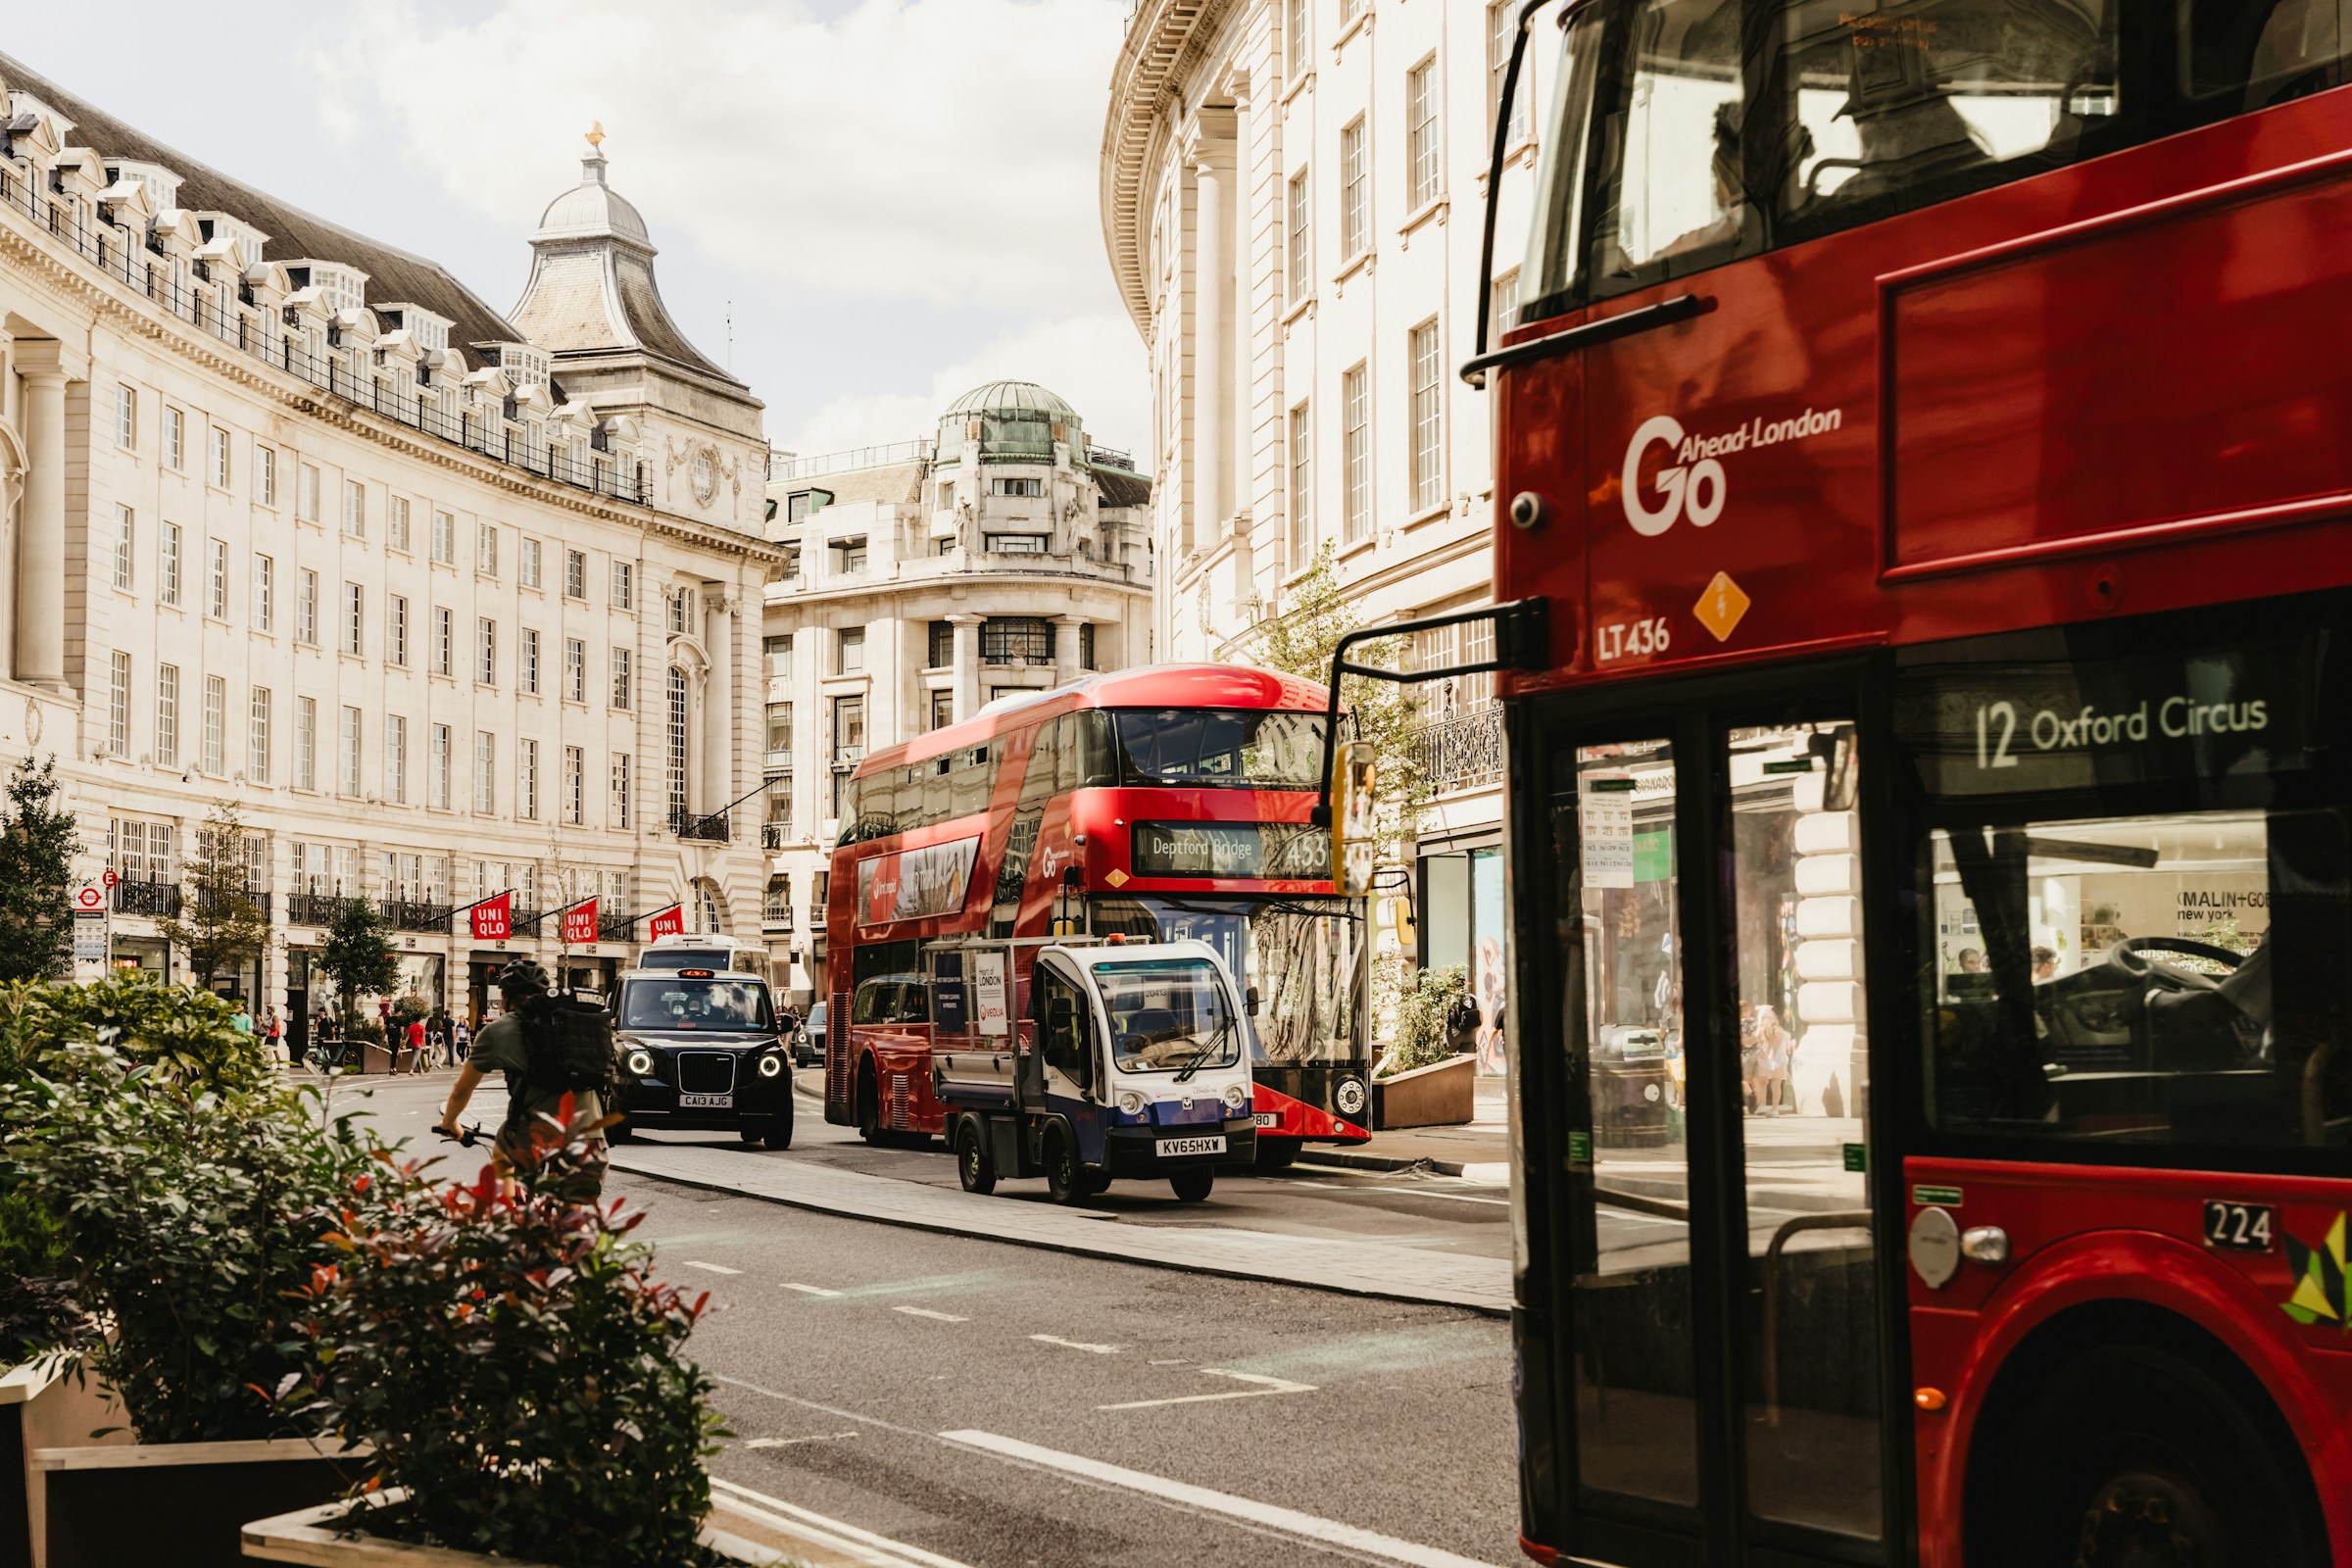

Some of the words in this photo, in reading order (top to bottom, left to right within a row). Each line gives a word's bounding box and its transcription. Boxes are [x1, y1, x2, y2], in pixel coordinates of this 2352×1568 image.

[1977, 700, 2019, 769] 12
[2031, 700, 2149, 751] Oxford
[2160, 696, 2268, 739] Circus
[1153, 837, 1207, 859] Deptford
[1213, 838, 1252, 860] Bridge
[1287, 833, 1327, 866] 453
[105, 872, 114, 885] E
[478, 907, 502, 921] UNI
[567, 912, 589, 926] UNI
[2178, 909, 2204, 920] new
[479, 921, 505, 937] QLO
[656, 919, 677, 932] UNI
[566, 926, 592, 939] QLO
[979, 967, 990, 976] Heart
[979, 975, 1002, 987] LONDON
[1145, 988, 1167, 998] 20413
[986, 1007, 1004, 1017] VEOLIA
[685, 1096, 707, 1105] CA13
[709, 1097, 727, 1106] AJG
[2212, 1203, 2272, 1246] 224
